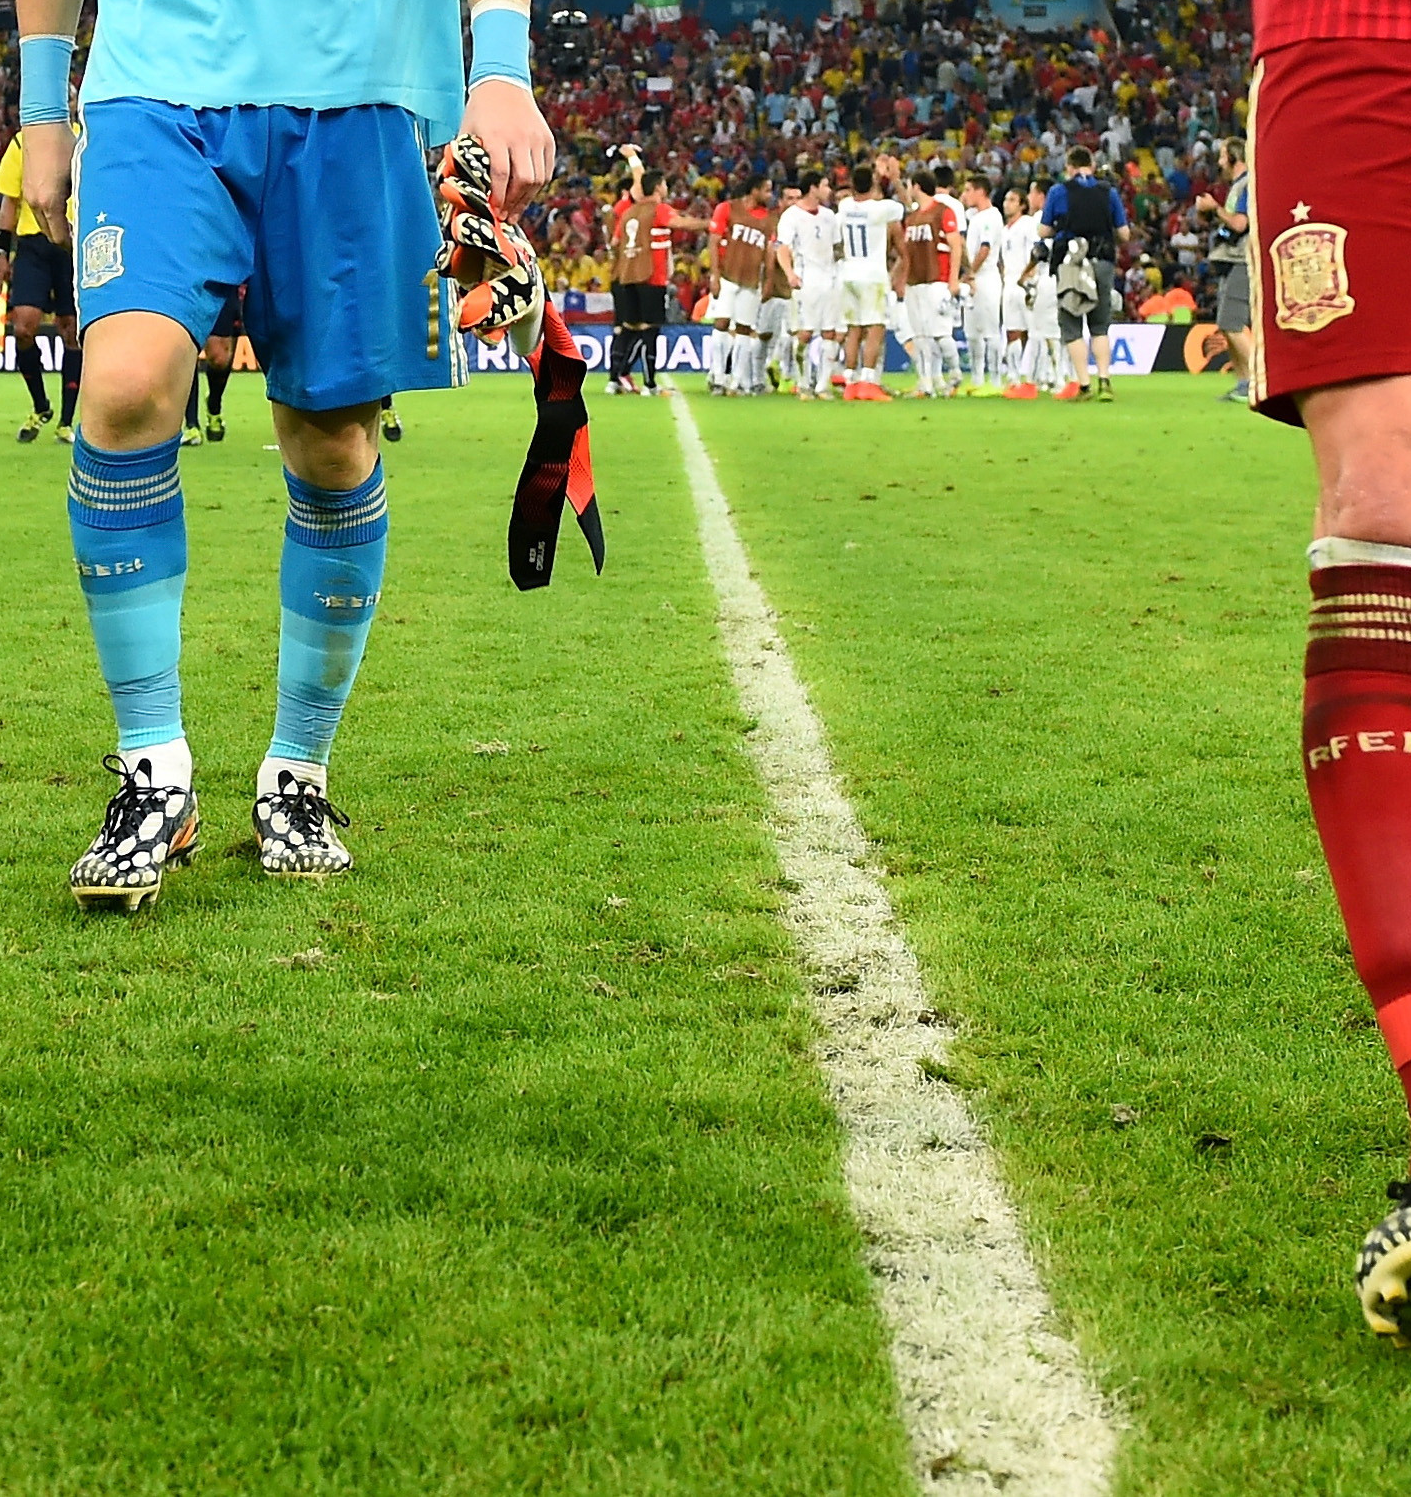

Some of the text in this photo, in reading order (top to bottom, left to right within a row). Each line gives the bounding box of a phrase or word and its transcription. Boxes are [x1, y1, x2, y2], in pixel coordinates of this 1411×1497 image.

[731, 223, 766, 249] FIFA
[846, 224, 868, 258] 11
[477, 335, 530, 371] RI
